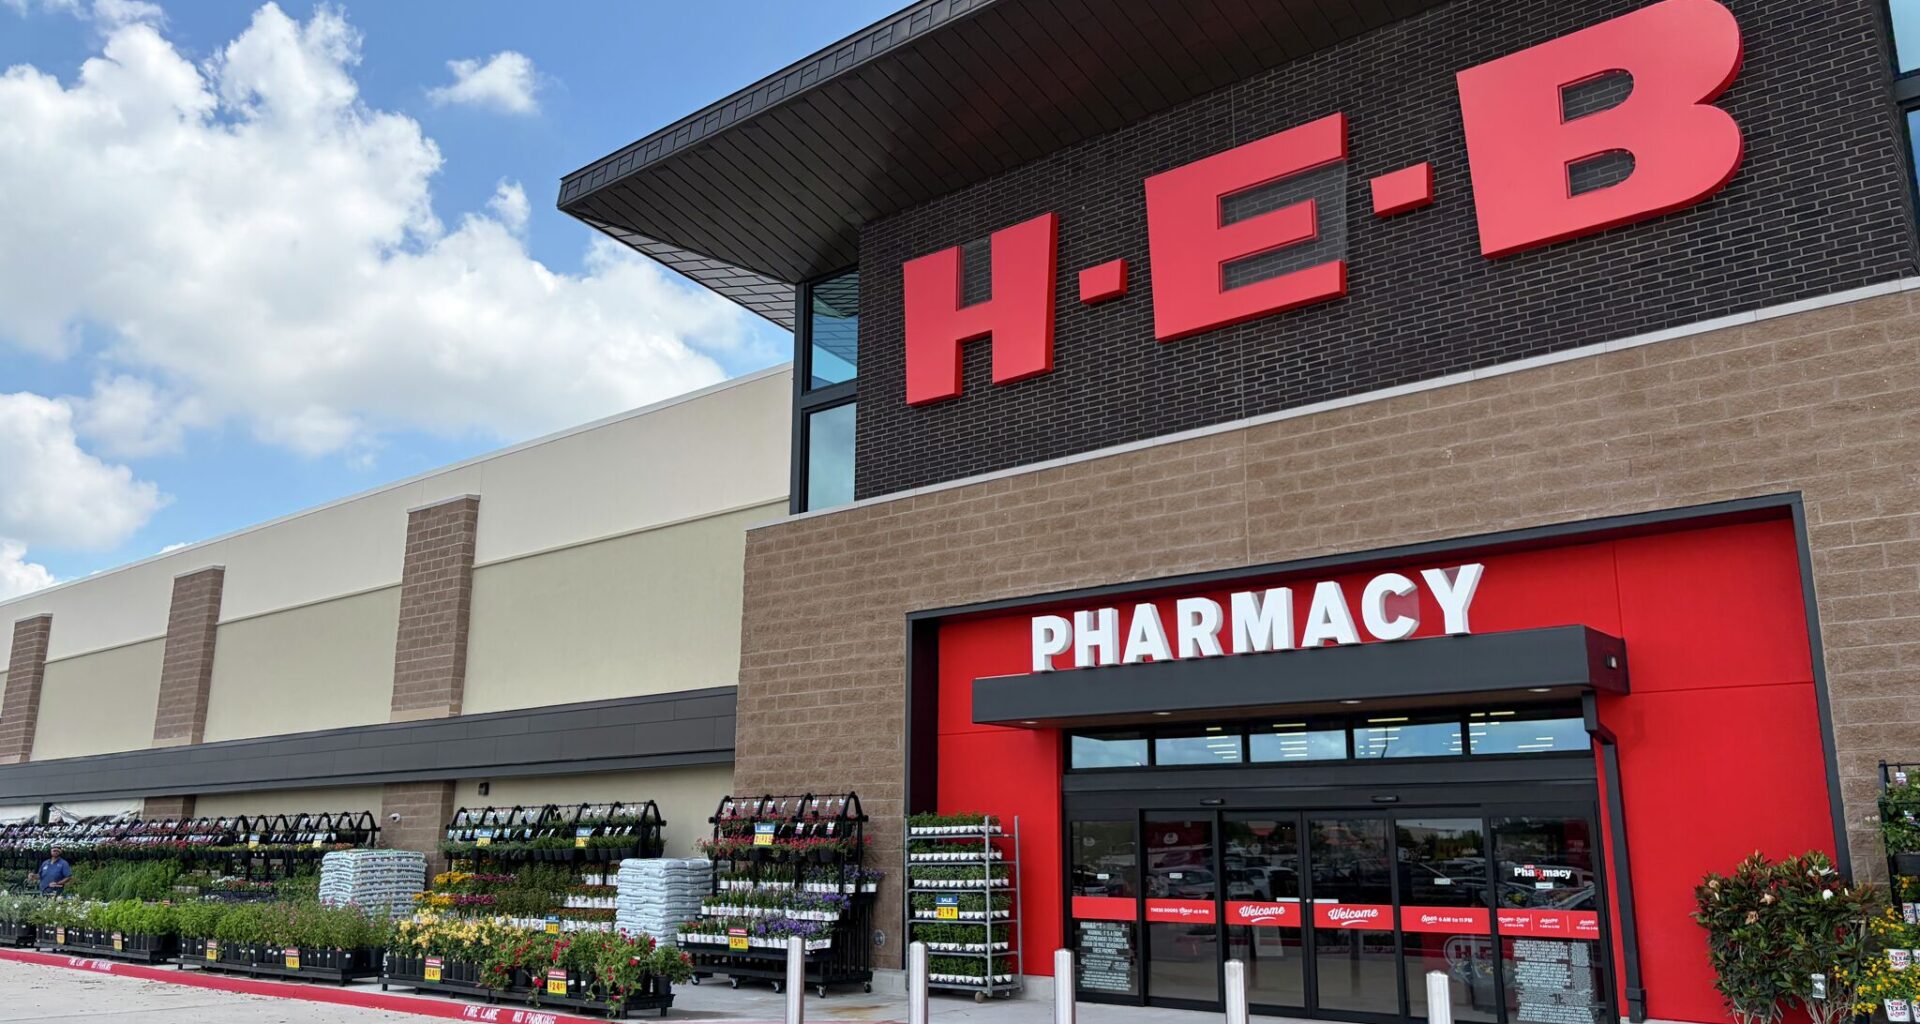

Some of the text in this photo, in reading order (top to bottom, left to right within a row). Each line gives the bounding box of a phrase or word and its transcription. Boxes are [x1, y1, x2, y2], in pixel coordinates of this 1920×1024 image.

[904, 0, 1743, 405] H-E-B
[1031, 563, 1485, 672] PHARMACY
[1239, 905, 1285, 917] Welcome
[1327, 907, 1378, 920] Welcome
[480, 1007, 500, 1020] LANE
[512, 1011, 523, 1022] NO
[525, 1012, 557, 1024] PARKING
